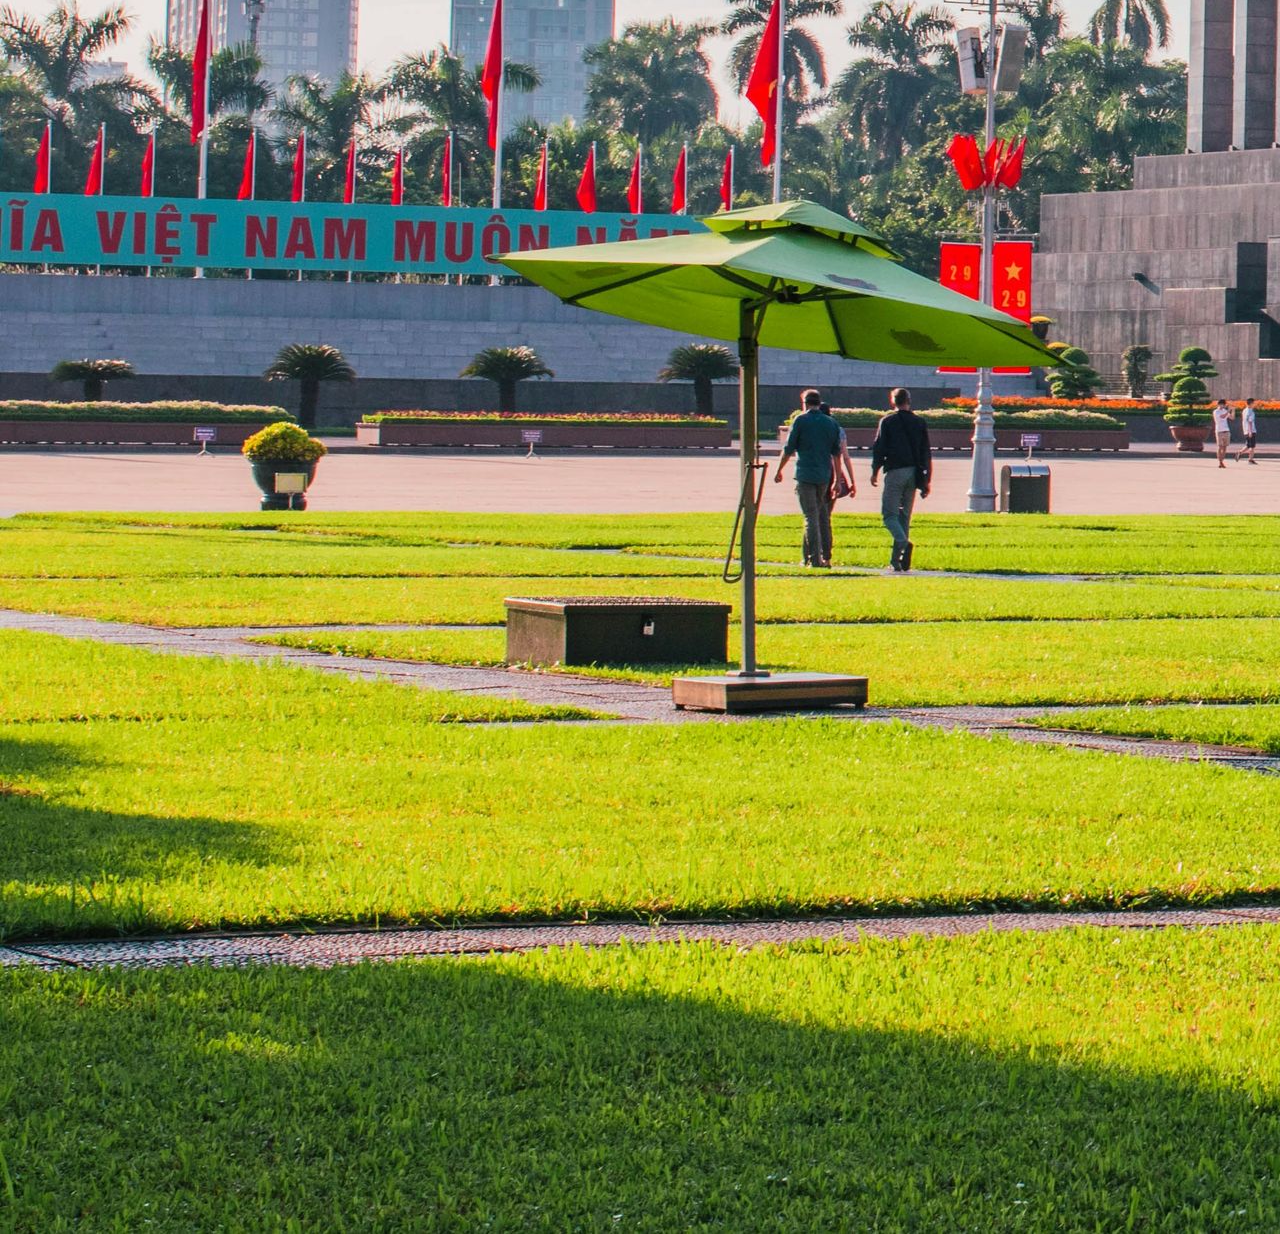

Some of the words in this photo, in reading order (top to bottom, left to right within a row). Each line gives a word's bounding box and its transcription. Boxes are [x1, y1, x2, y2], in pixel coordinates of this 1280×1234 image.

[0, 199, 64, 252] ĨA
[96, 204, 217, 263] VIỆT
[245, 215, 367, 260] NAM
[394, 215, 549, 264] MUÔN
